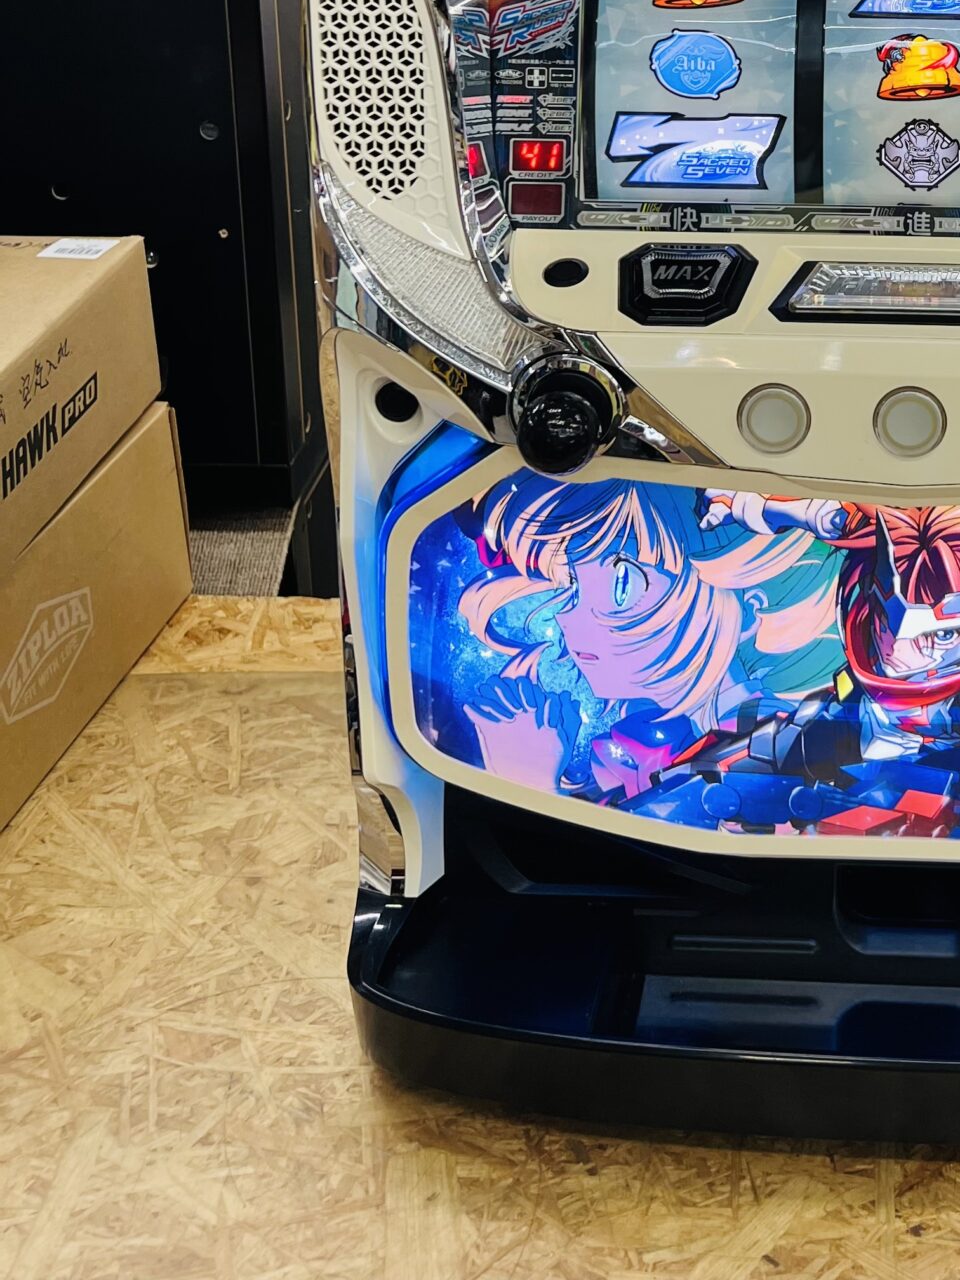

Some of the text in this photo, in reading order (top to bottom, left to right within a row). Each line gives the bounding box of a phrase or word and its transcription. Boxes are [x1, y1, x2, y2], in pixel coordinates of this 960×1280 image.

[520, 142, 561, 169] 41
[678, 152, 752, 169] SACRED
[683, 165, 750, 179] SEVEN
[672, 206, 699, 233] 快
[904, 210, 937, 237] 進
[652, 264, 714, 282] MAX
[1, 375, 97, 500] HAWK PRO
